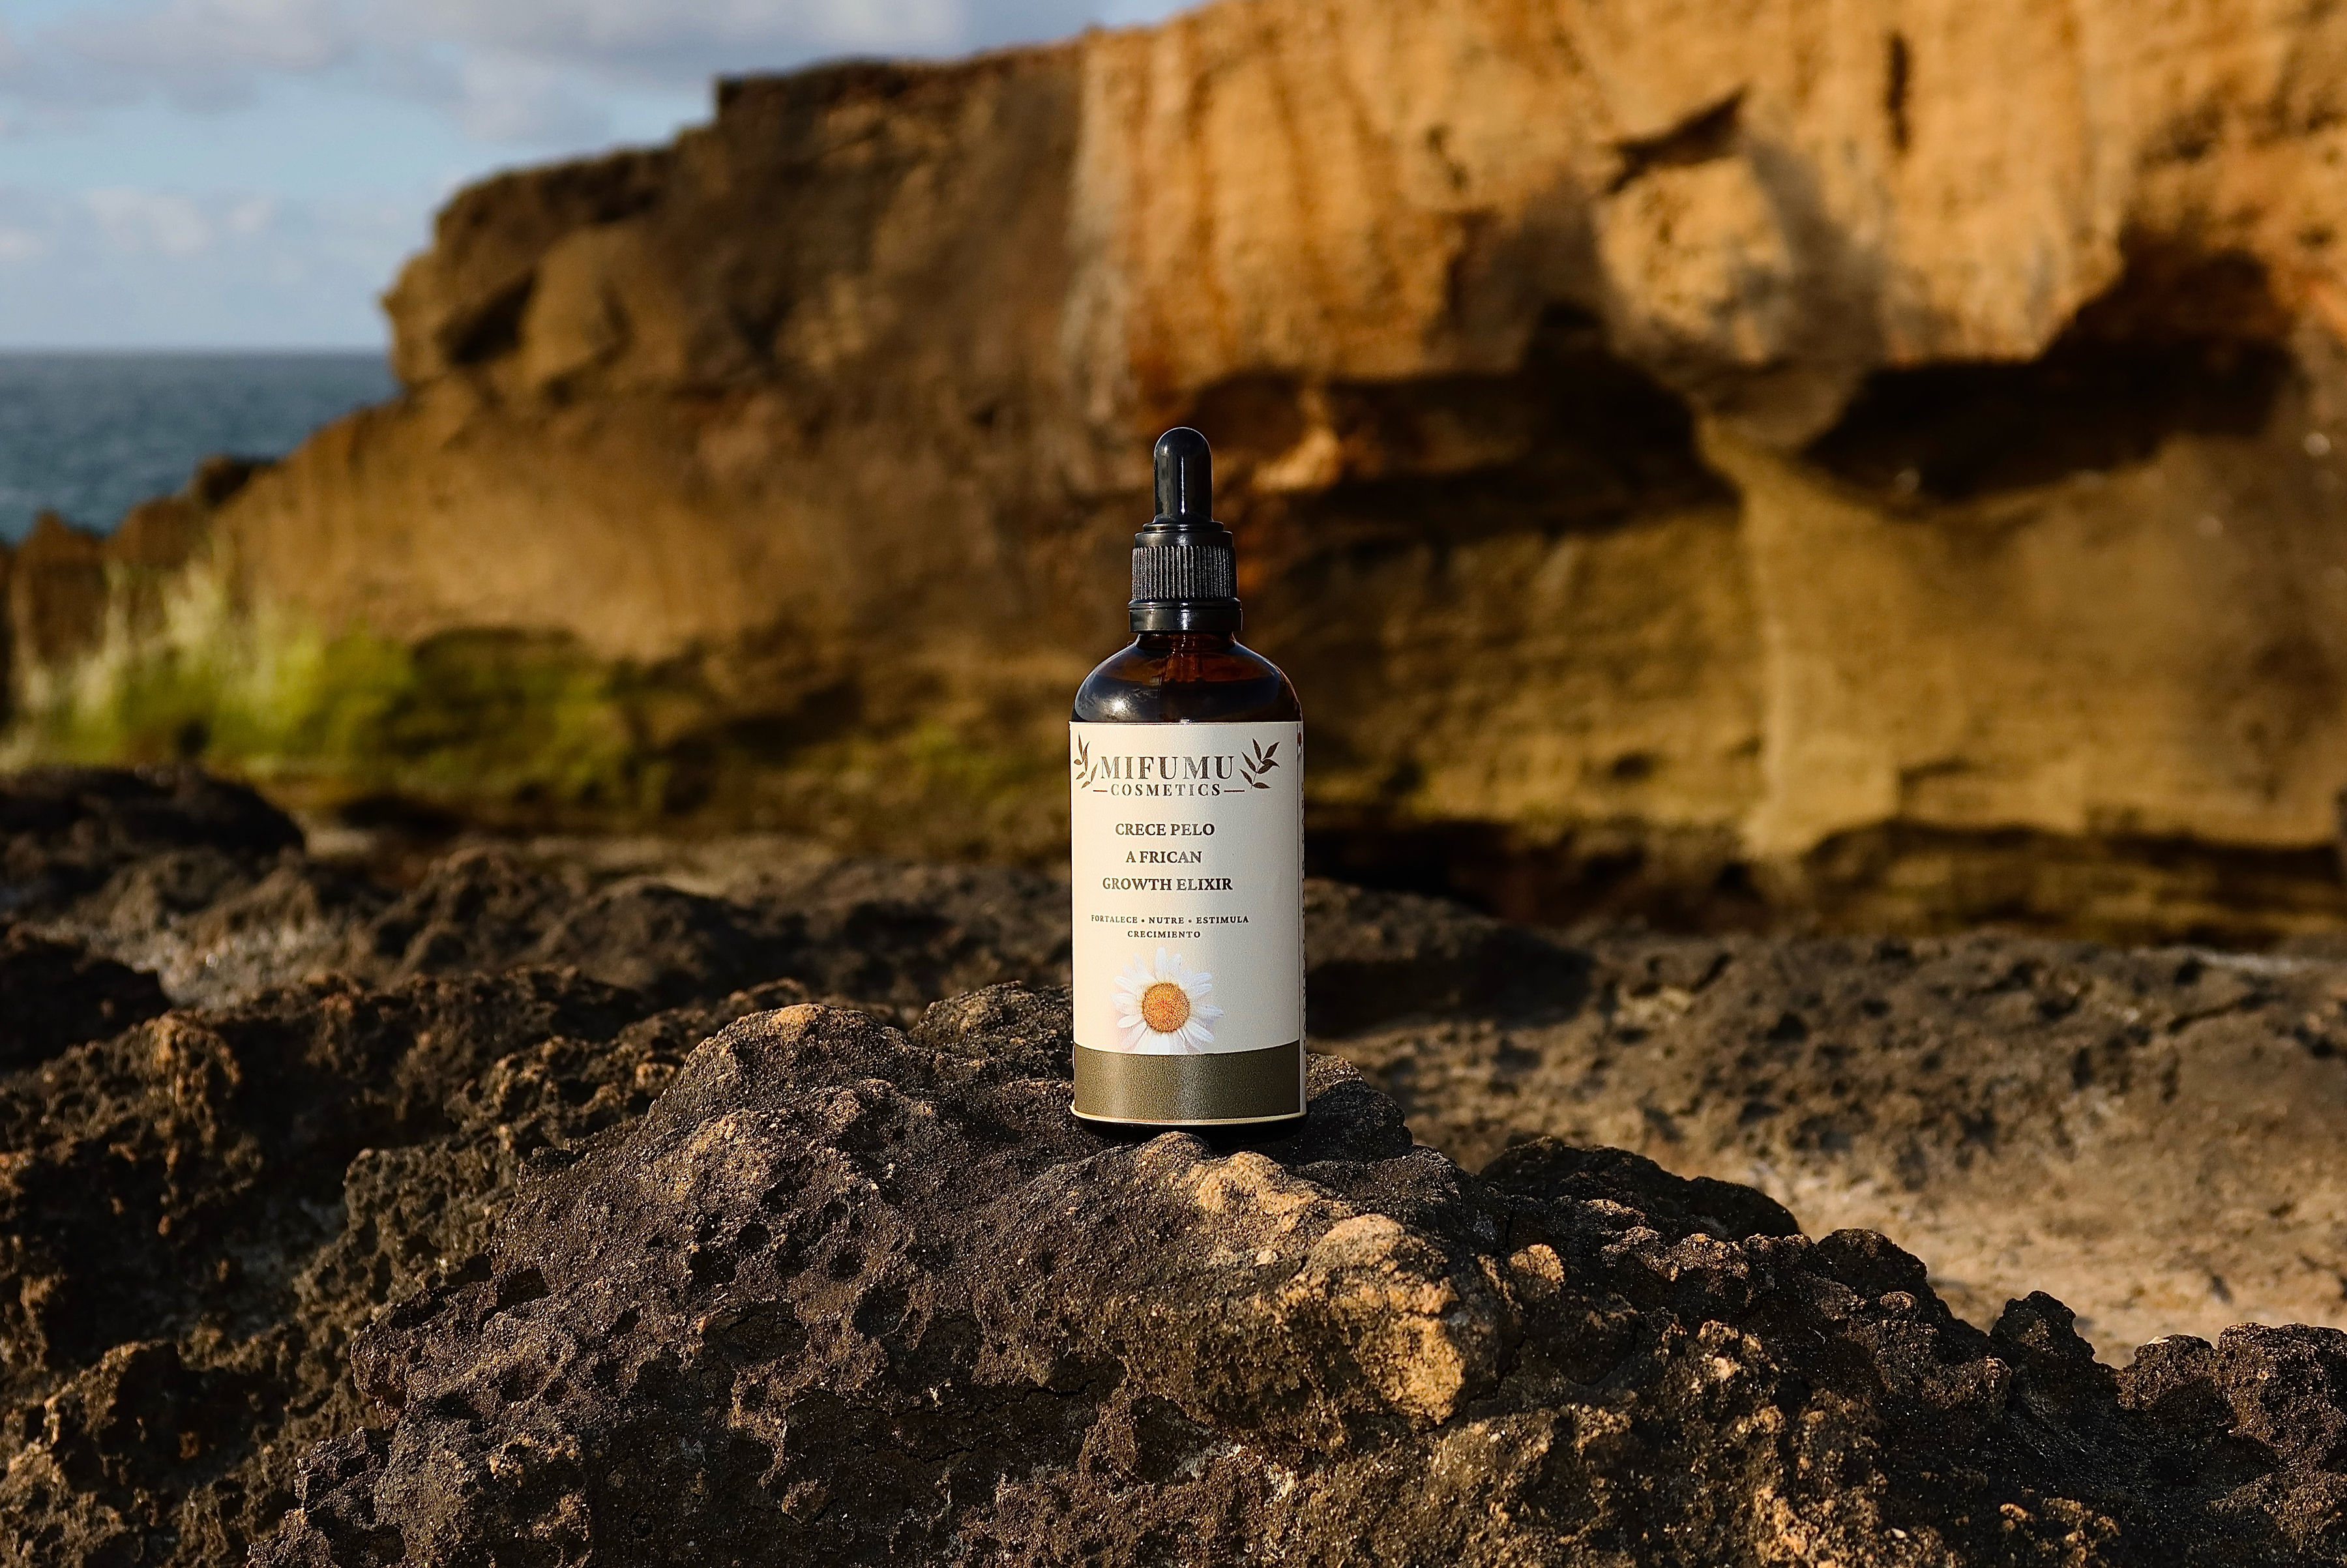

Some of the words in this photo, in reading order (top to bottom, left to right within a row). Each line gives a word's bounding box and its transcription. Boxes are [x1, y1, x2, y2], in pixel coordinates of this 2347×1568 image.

[1100, 756, 1234, 780] MIFUMU
[1111, 784, 1220, 796] COSMETICS
[1115, 823, 1166, 836] CRECE
[1170, 823, 1215, 836] PELO
[1103, 878, 1172, 891] GROWTH
[1176, 878, 1233, 891] ELIXIR
[1091, 915, 1138, 924] FORTALECE
[1196, 915, 1249, 924] ESTIMULA
[1128, 930, 1201, 938] CRECIMIENTO
